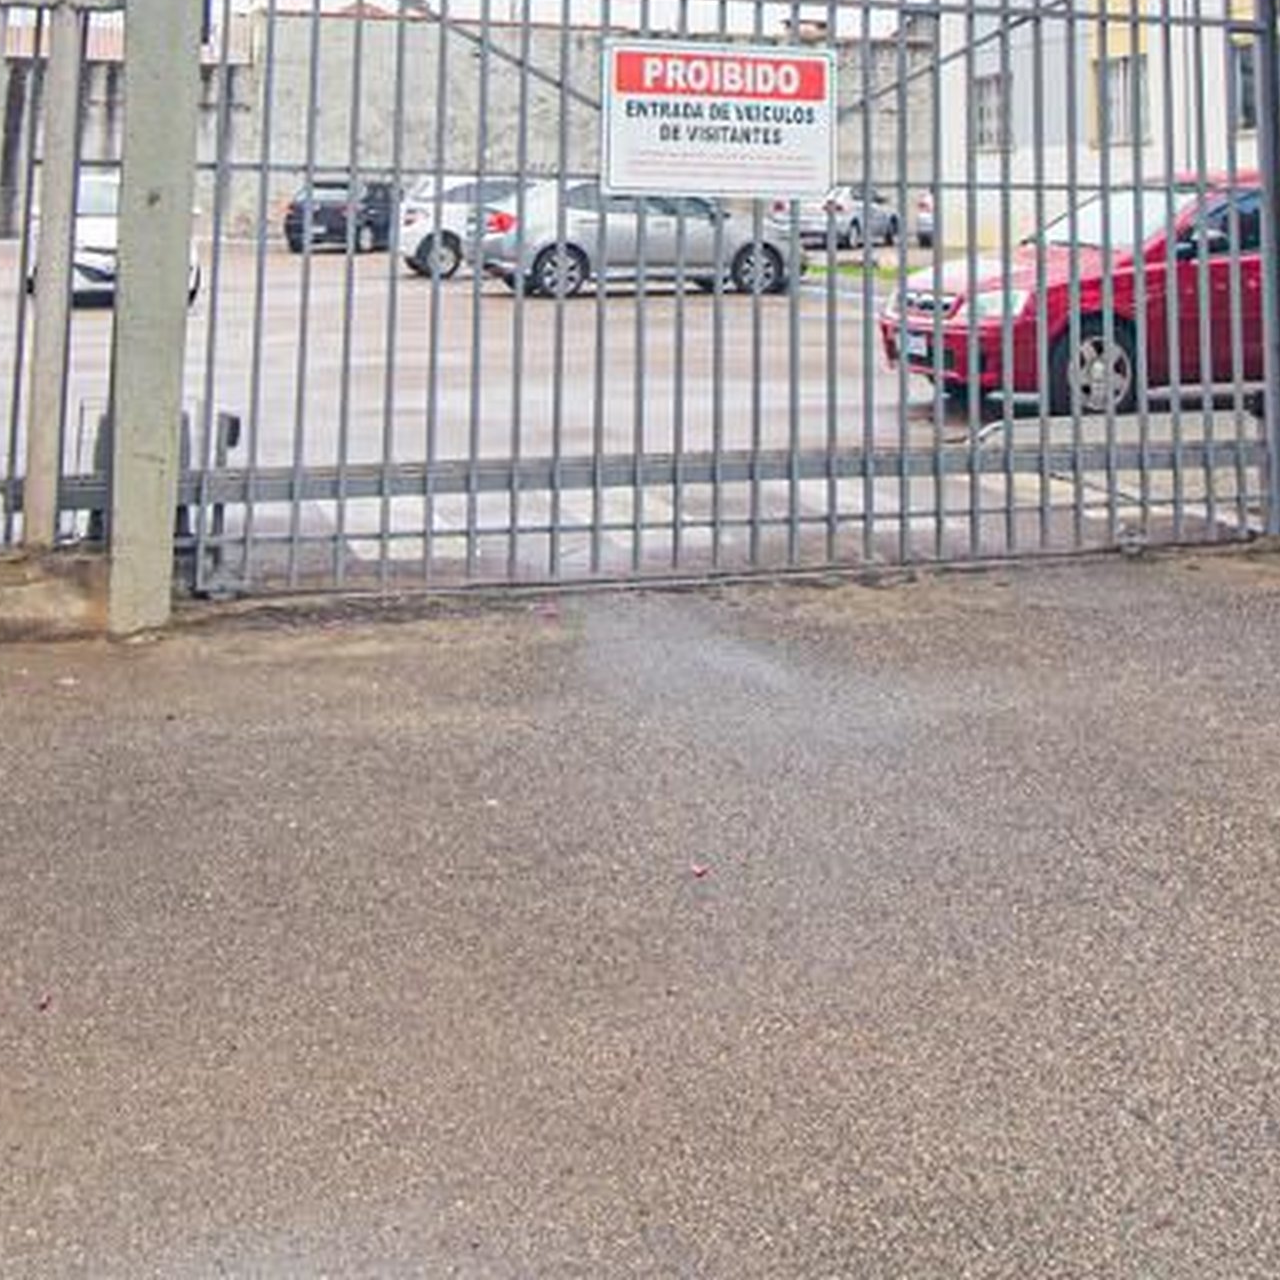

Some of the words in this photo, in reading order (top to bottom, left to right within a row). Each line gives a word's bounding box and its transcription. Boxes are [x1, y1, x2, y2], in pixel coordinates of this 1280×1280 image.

[642, 56, 801, 94] PROIBIDO
[625, 99, 705, 120] ENTRADA
[708, 102, 731, 121] DE
[659, 123, 680, 142] DE
[685, 124, 784, 146] VISITANTES
